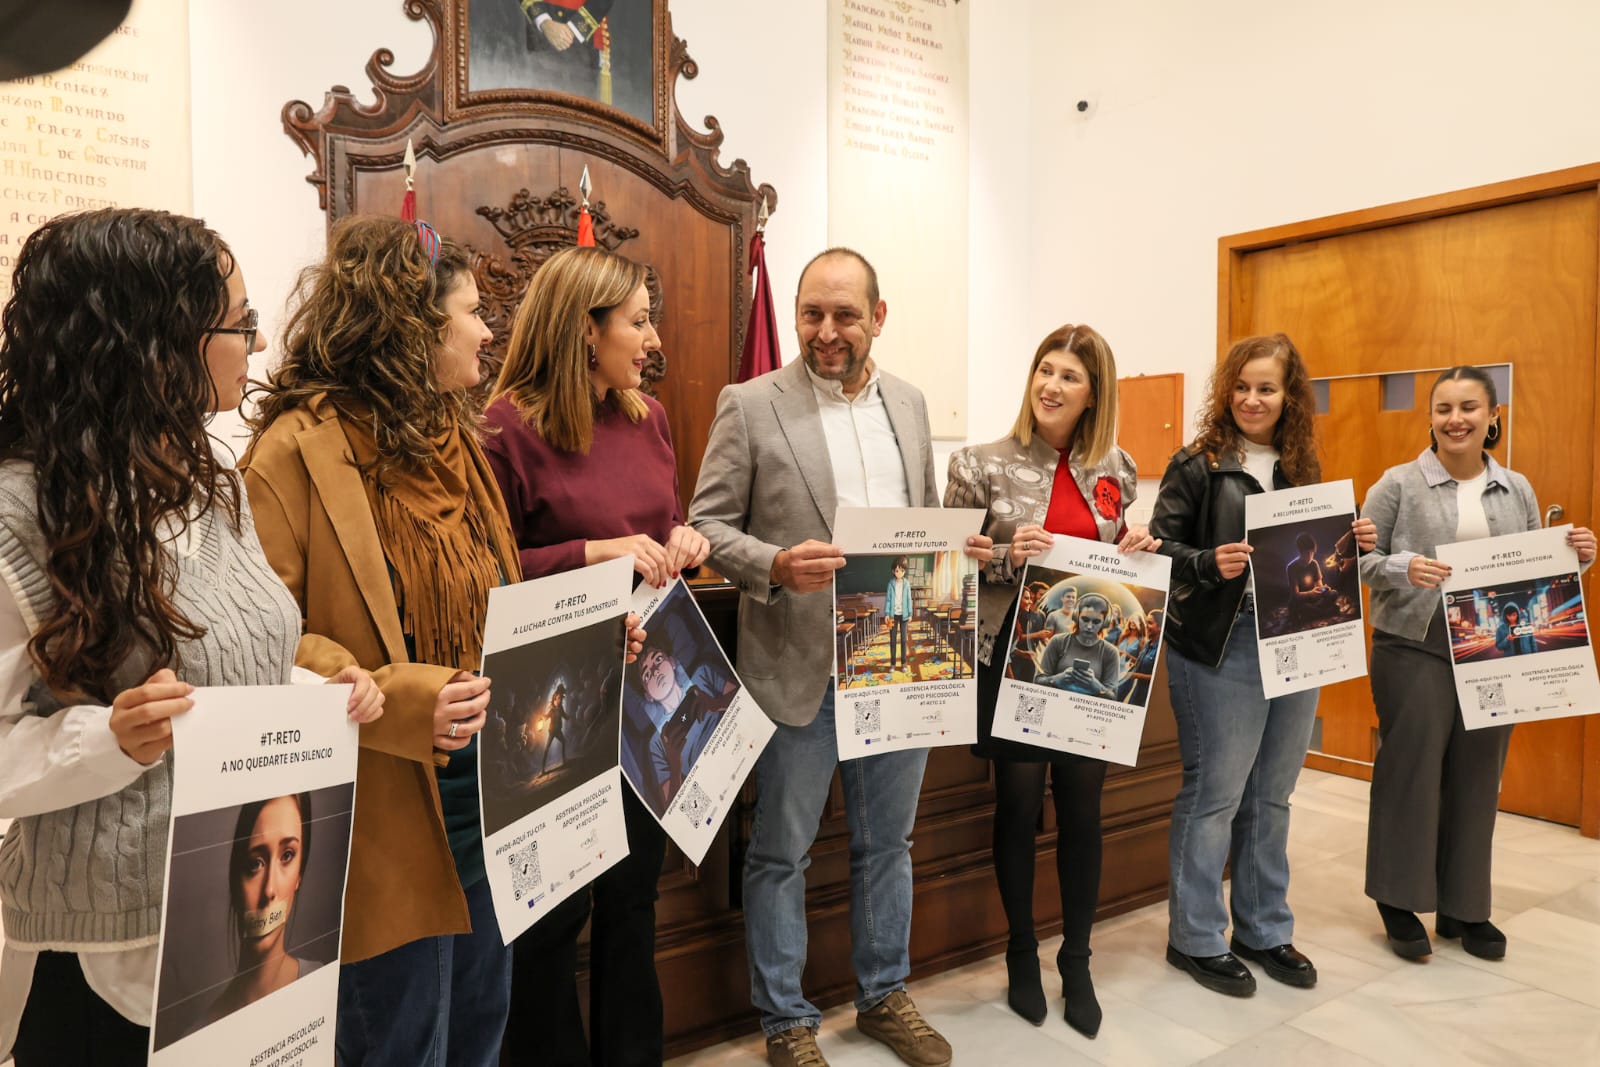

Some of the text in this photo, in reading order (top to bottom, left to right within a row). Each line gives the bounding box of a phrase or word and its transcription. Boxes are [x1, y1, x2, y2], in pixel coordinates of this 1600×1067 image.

[894, 530, 926, 539] #T-RETO
[878, 541, 913, 550] CONSTRUIR
[923, 540, 948, 549] FUTURO
[1088, 553, 1121, 566] #T-RETO
[1491, 550, 1522, 561] #T-RETO
[1074, 560, 1091, 570] SALIR
[1092, 564, 1100, 572] DE
[554, 593, 588, 611] #T-RETO
[512, 597, 620, 636] A LUCHAR CONTRA TUS MONSTRUOS
[260, 729, 301, 747] #T-RETO
[221, 747, 334, 774] A NO QUEDARTE EN SILENCIO
[555, 784, 612, 822] ASISTENCIA PSICOLÓGICA
[562, 798, 608, 829] APOYO PSICOSOCIAL
[281, 1035, 319, 1066] PSICOSOCIAL
